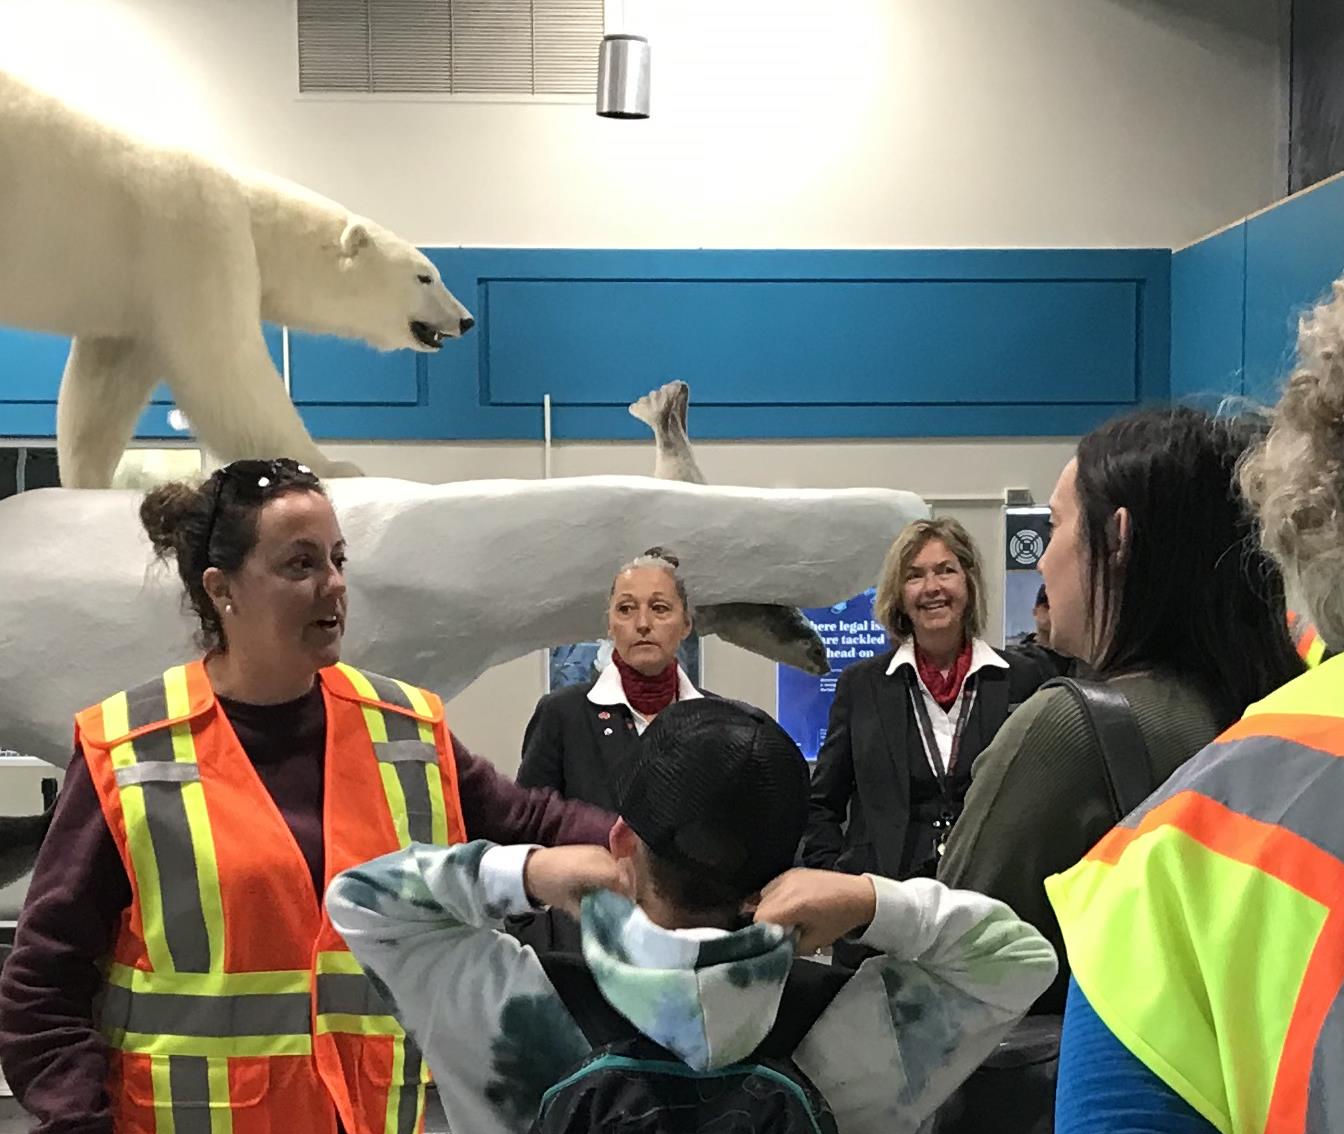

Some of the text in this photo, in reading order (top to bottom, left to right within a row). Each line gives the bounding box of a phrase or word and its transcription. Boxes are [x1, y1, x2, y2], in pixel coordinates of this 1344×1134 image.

[810, 620, 886, 635] here legal is
[841, 634, 885, 645] tackled
[826, 647, 874, 658] head on
